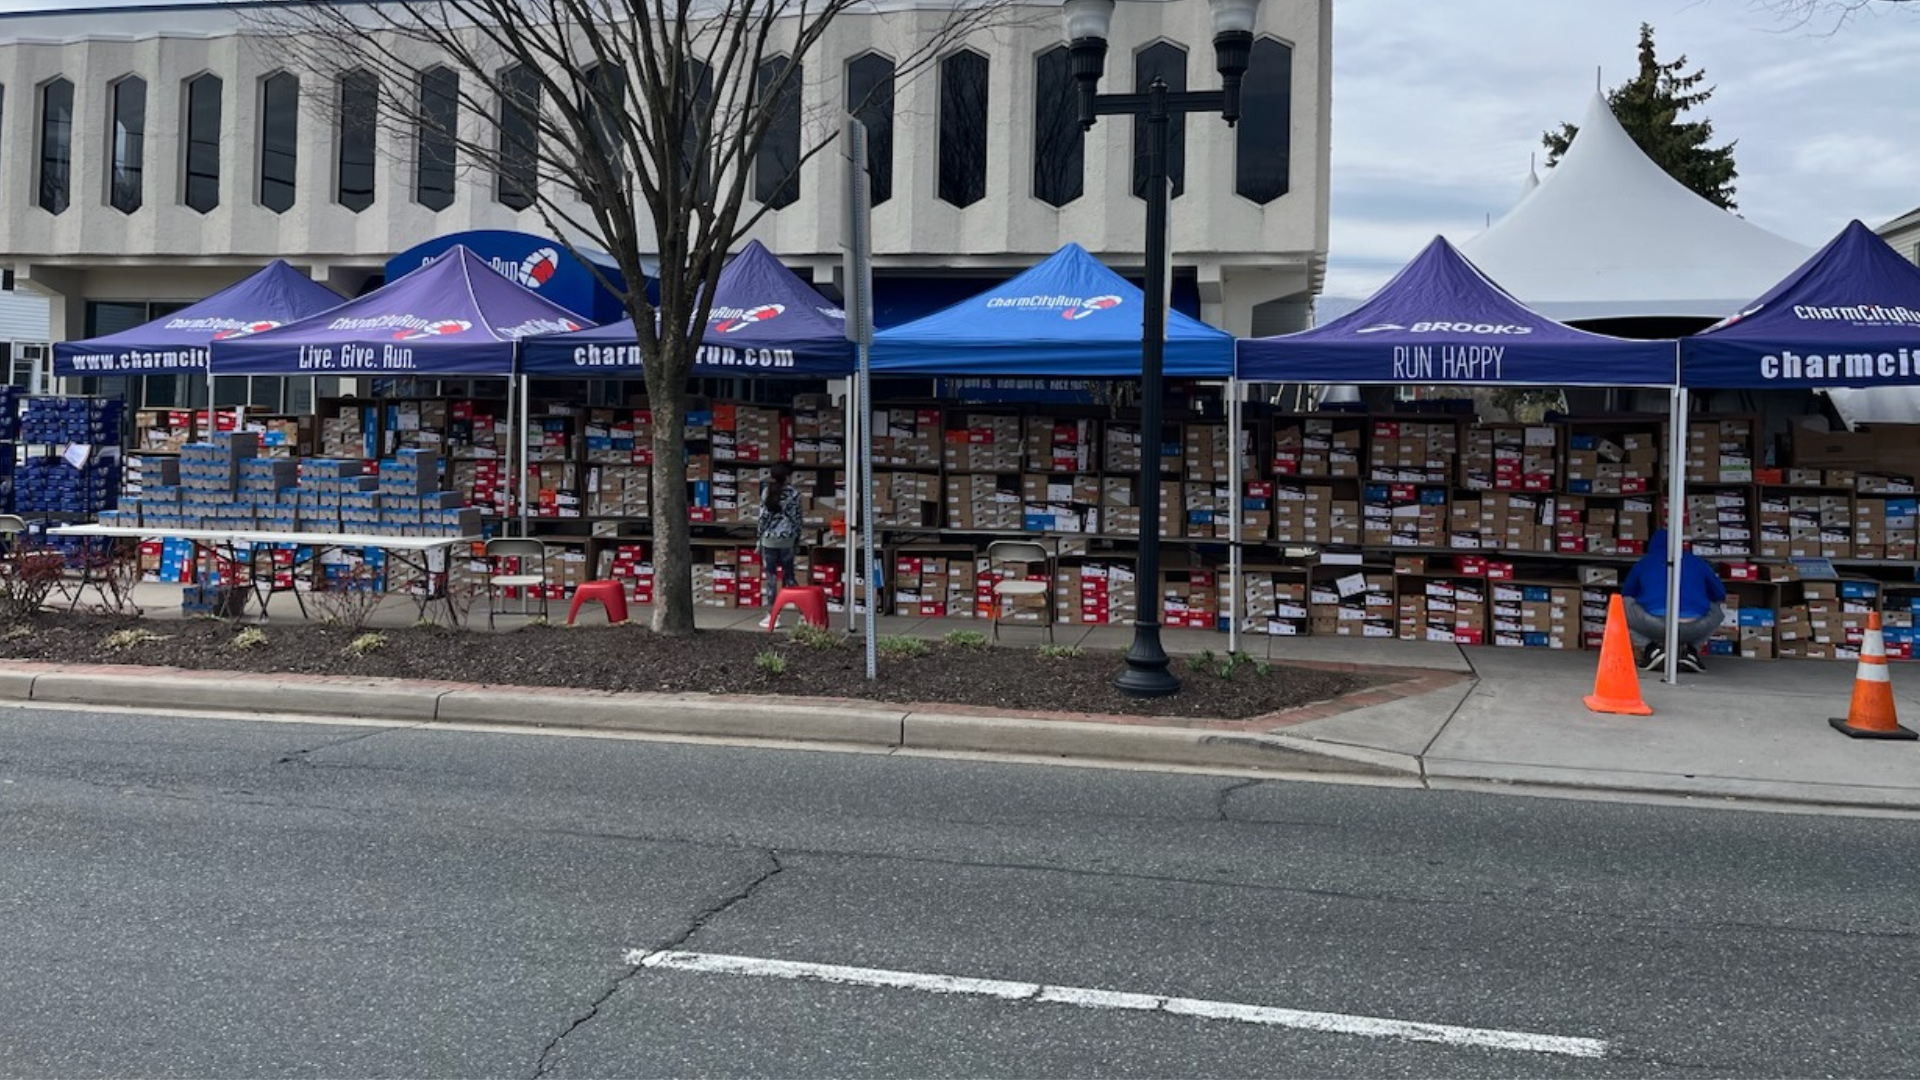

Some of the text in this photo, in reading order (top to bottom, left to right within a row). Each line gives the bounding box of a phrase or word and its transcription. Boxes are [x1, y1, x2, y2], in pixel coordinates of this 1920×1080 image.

[986, 295, 1083, 309] CharmCityRun
[1410, 322, 1533, 335] BROOKS
[299, 344, 417, 369] Live. Give. Run.
[574, 343, 795, 368] charmrun.com
[1393, 345, 1505, 380] RUN HAPPY
